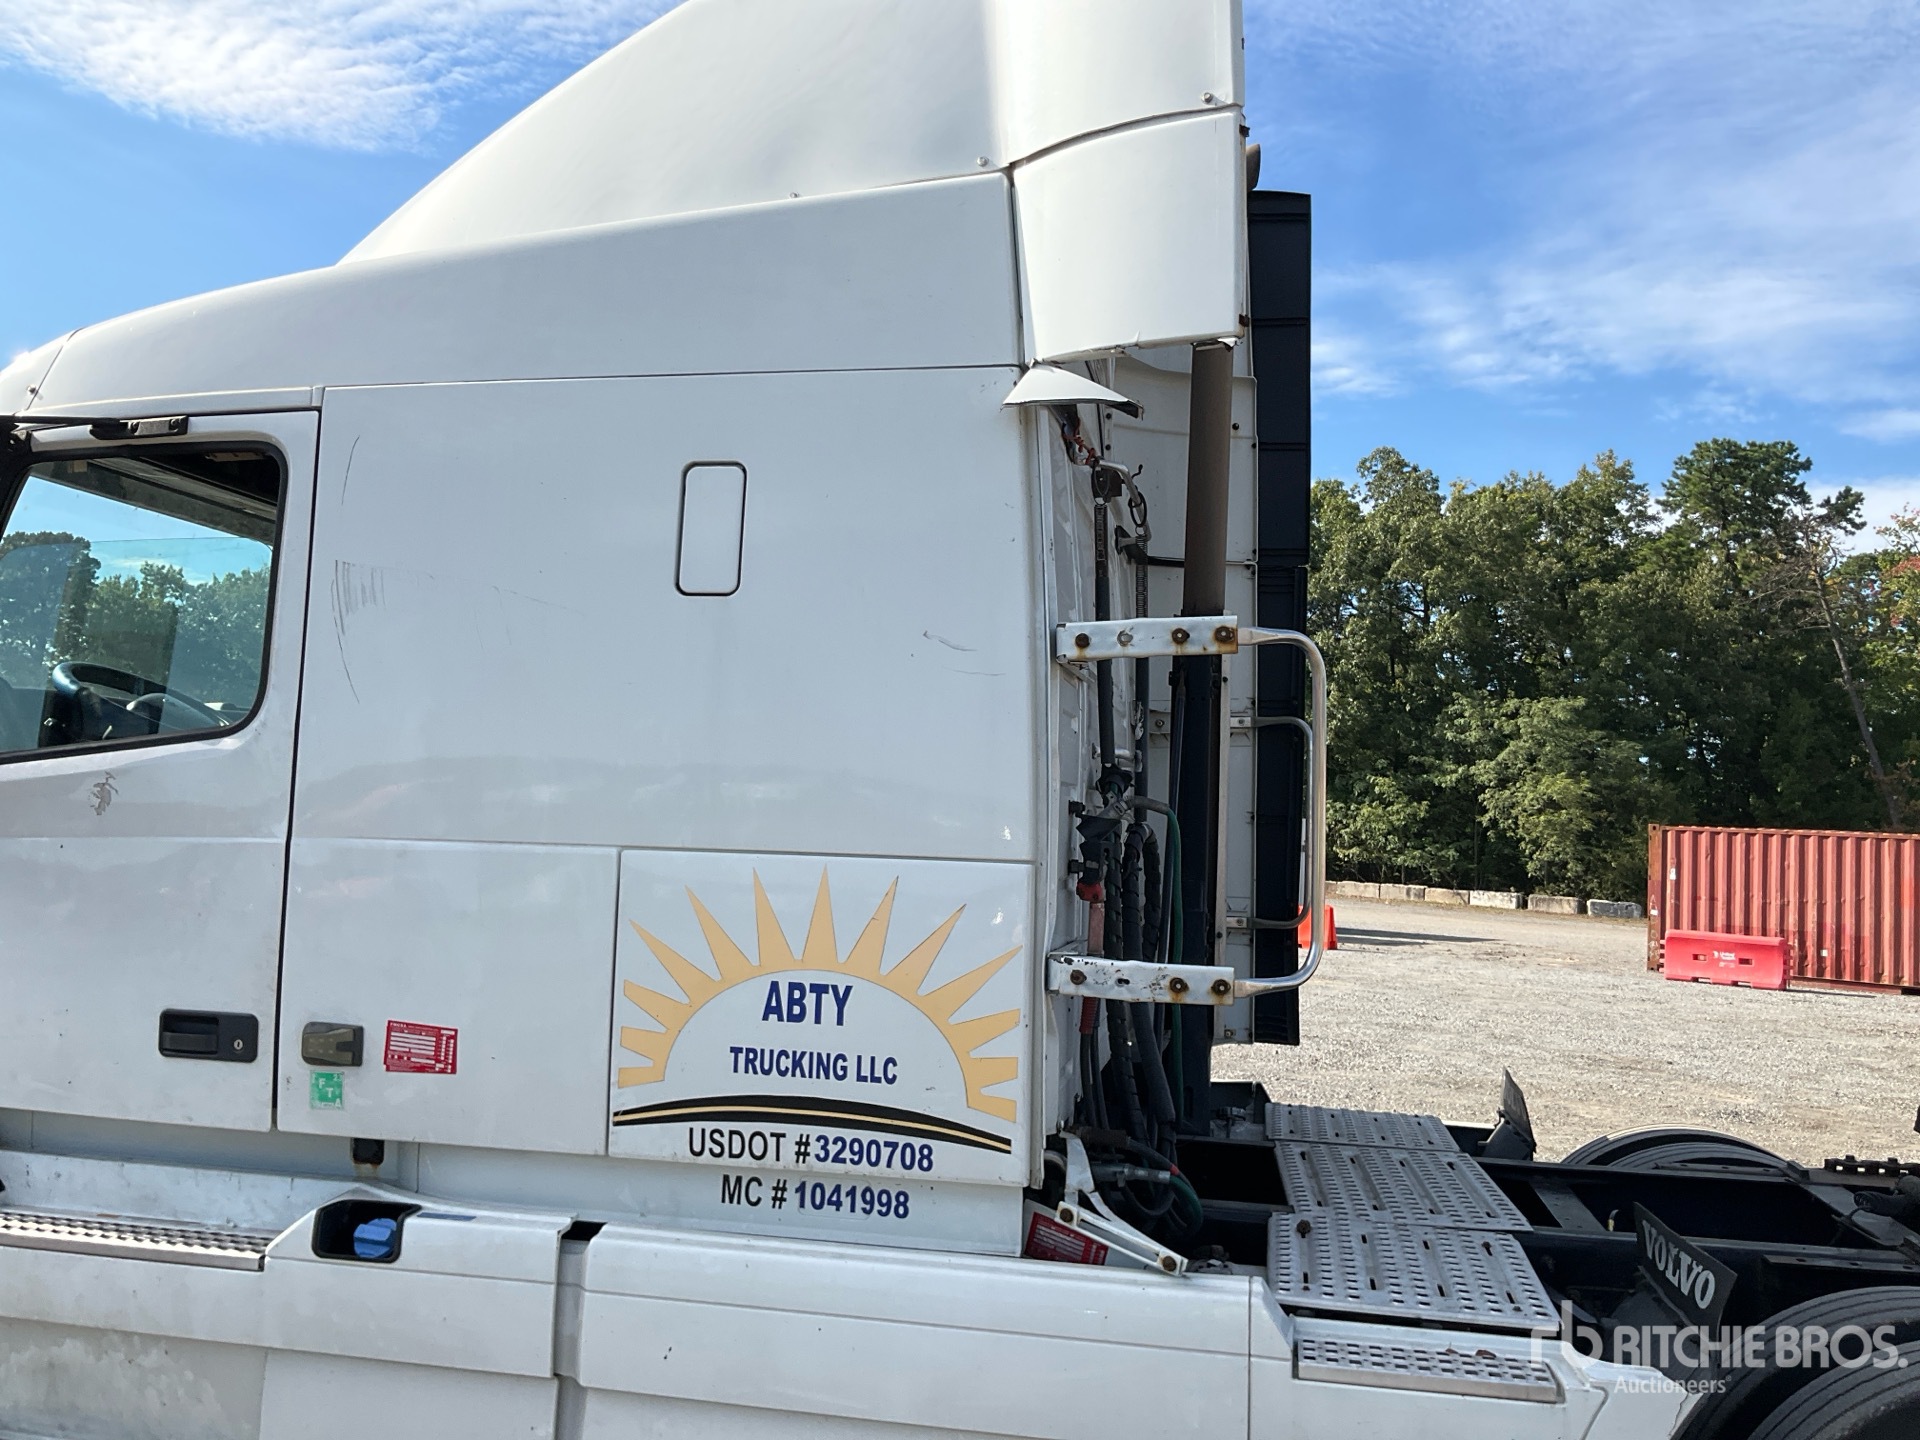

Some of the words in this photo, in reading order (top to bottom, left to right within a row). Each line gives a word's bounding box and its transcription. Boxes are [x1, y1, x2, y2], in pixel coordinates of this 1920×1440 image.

[762, 980, 853, 1026] ABTY
[730, 1046, 848, 1082] TRUCKING
[856, 1055, 898, 1085] LLC
[689, 1128, 786, 1163] USDOT
[721, 1174, 763, 1207] MC
[794, 1180, 910, 1219] 1041998
[1642, 1219, 1716, 1310] VOLVO
